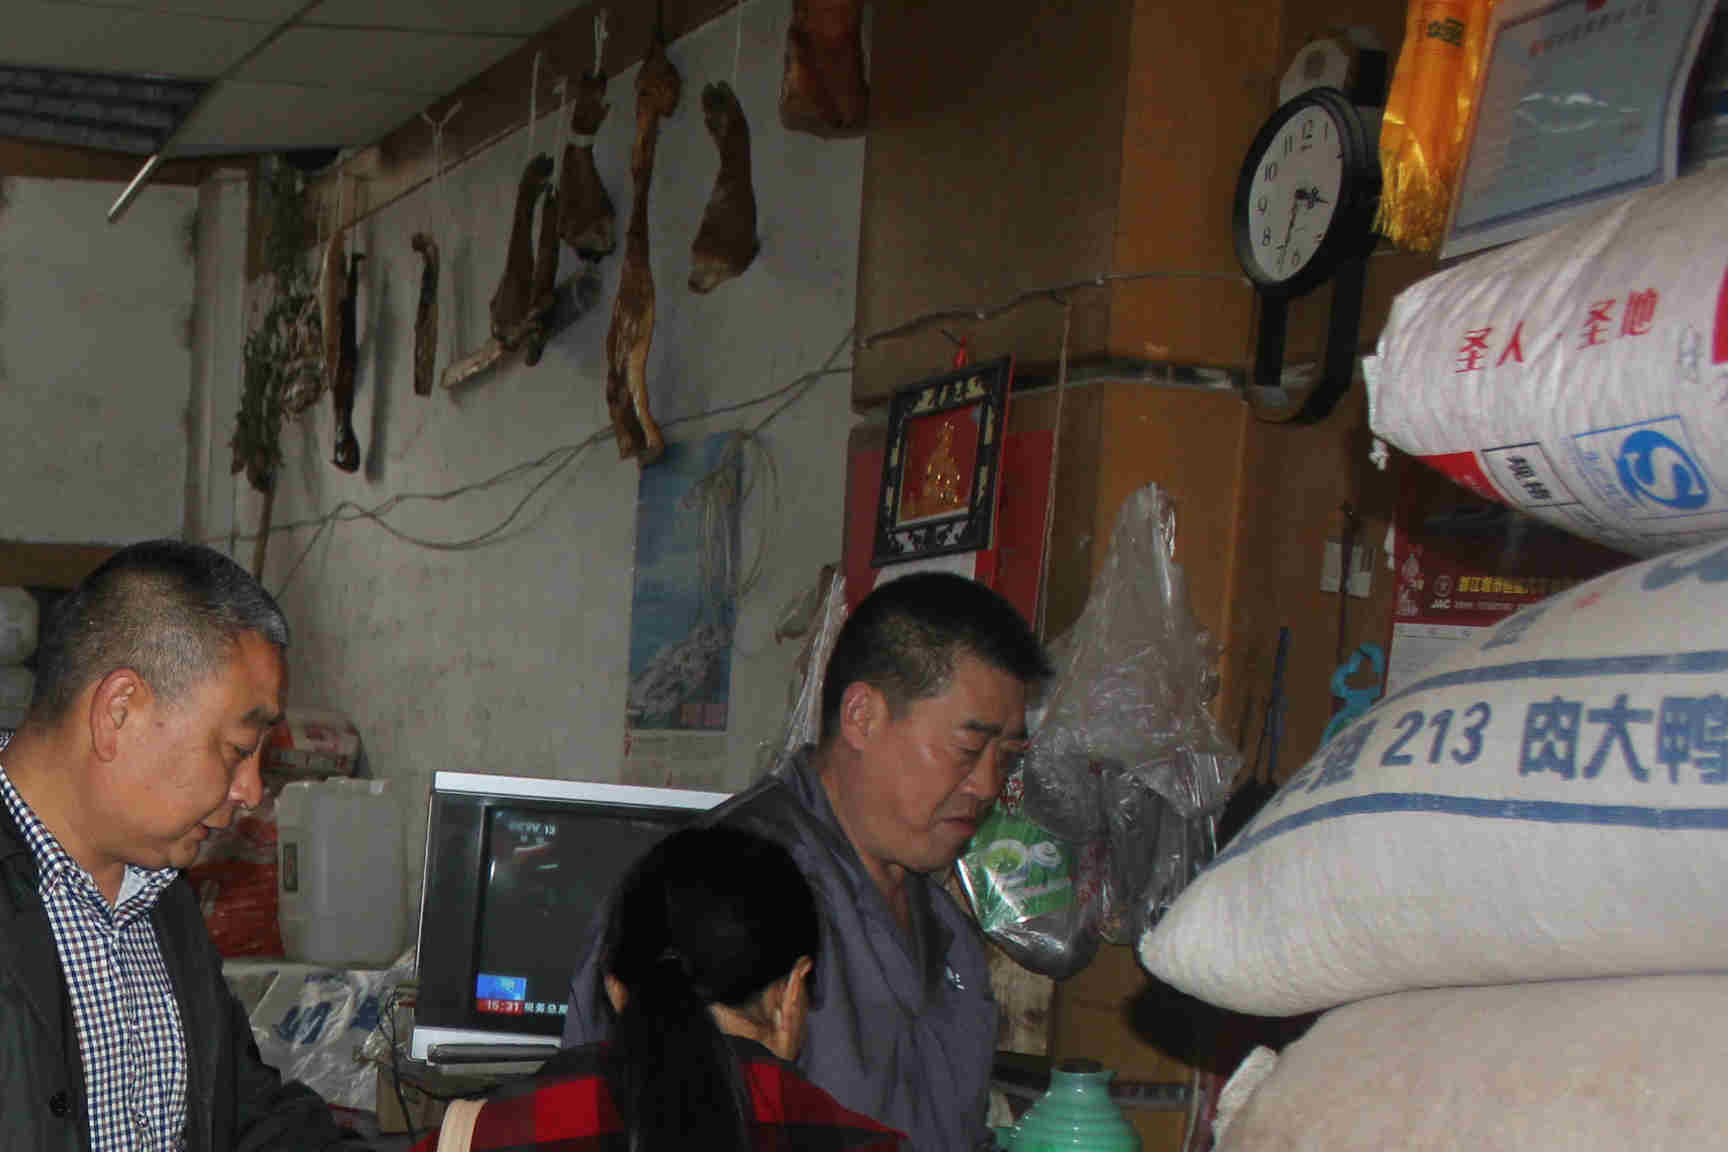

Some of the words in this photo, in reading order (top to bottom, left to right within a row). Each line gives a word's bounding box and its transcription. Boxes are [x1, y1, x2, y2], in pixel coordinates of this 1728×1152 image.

[1456, 326, 1525, 374] 圣人
[1576, 287, 1658, 352] 圣地
[1379, 700, 1492, 767] 213
[1517, 692, 1728, 786] 肉大鸭
